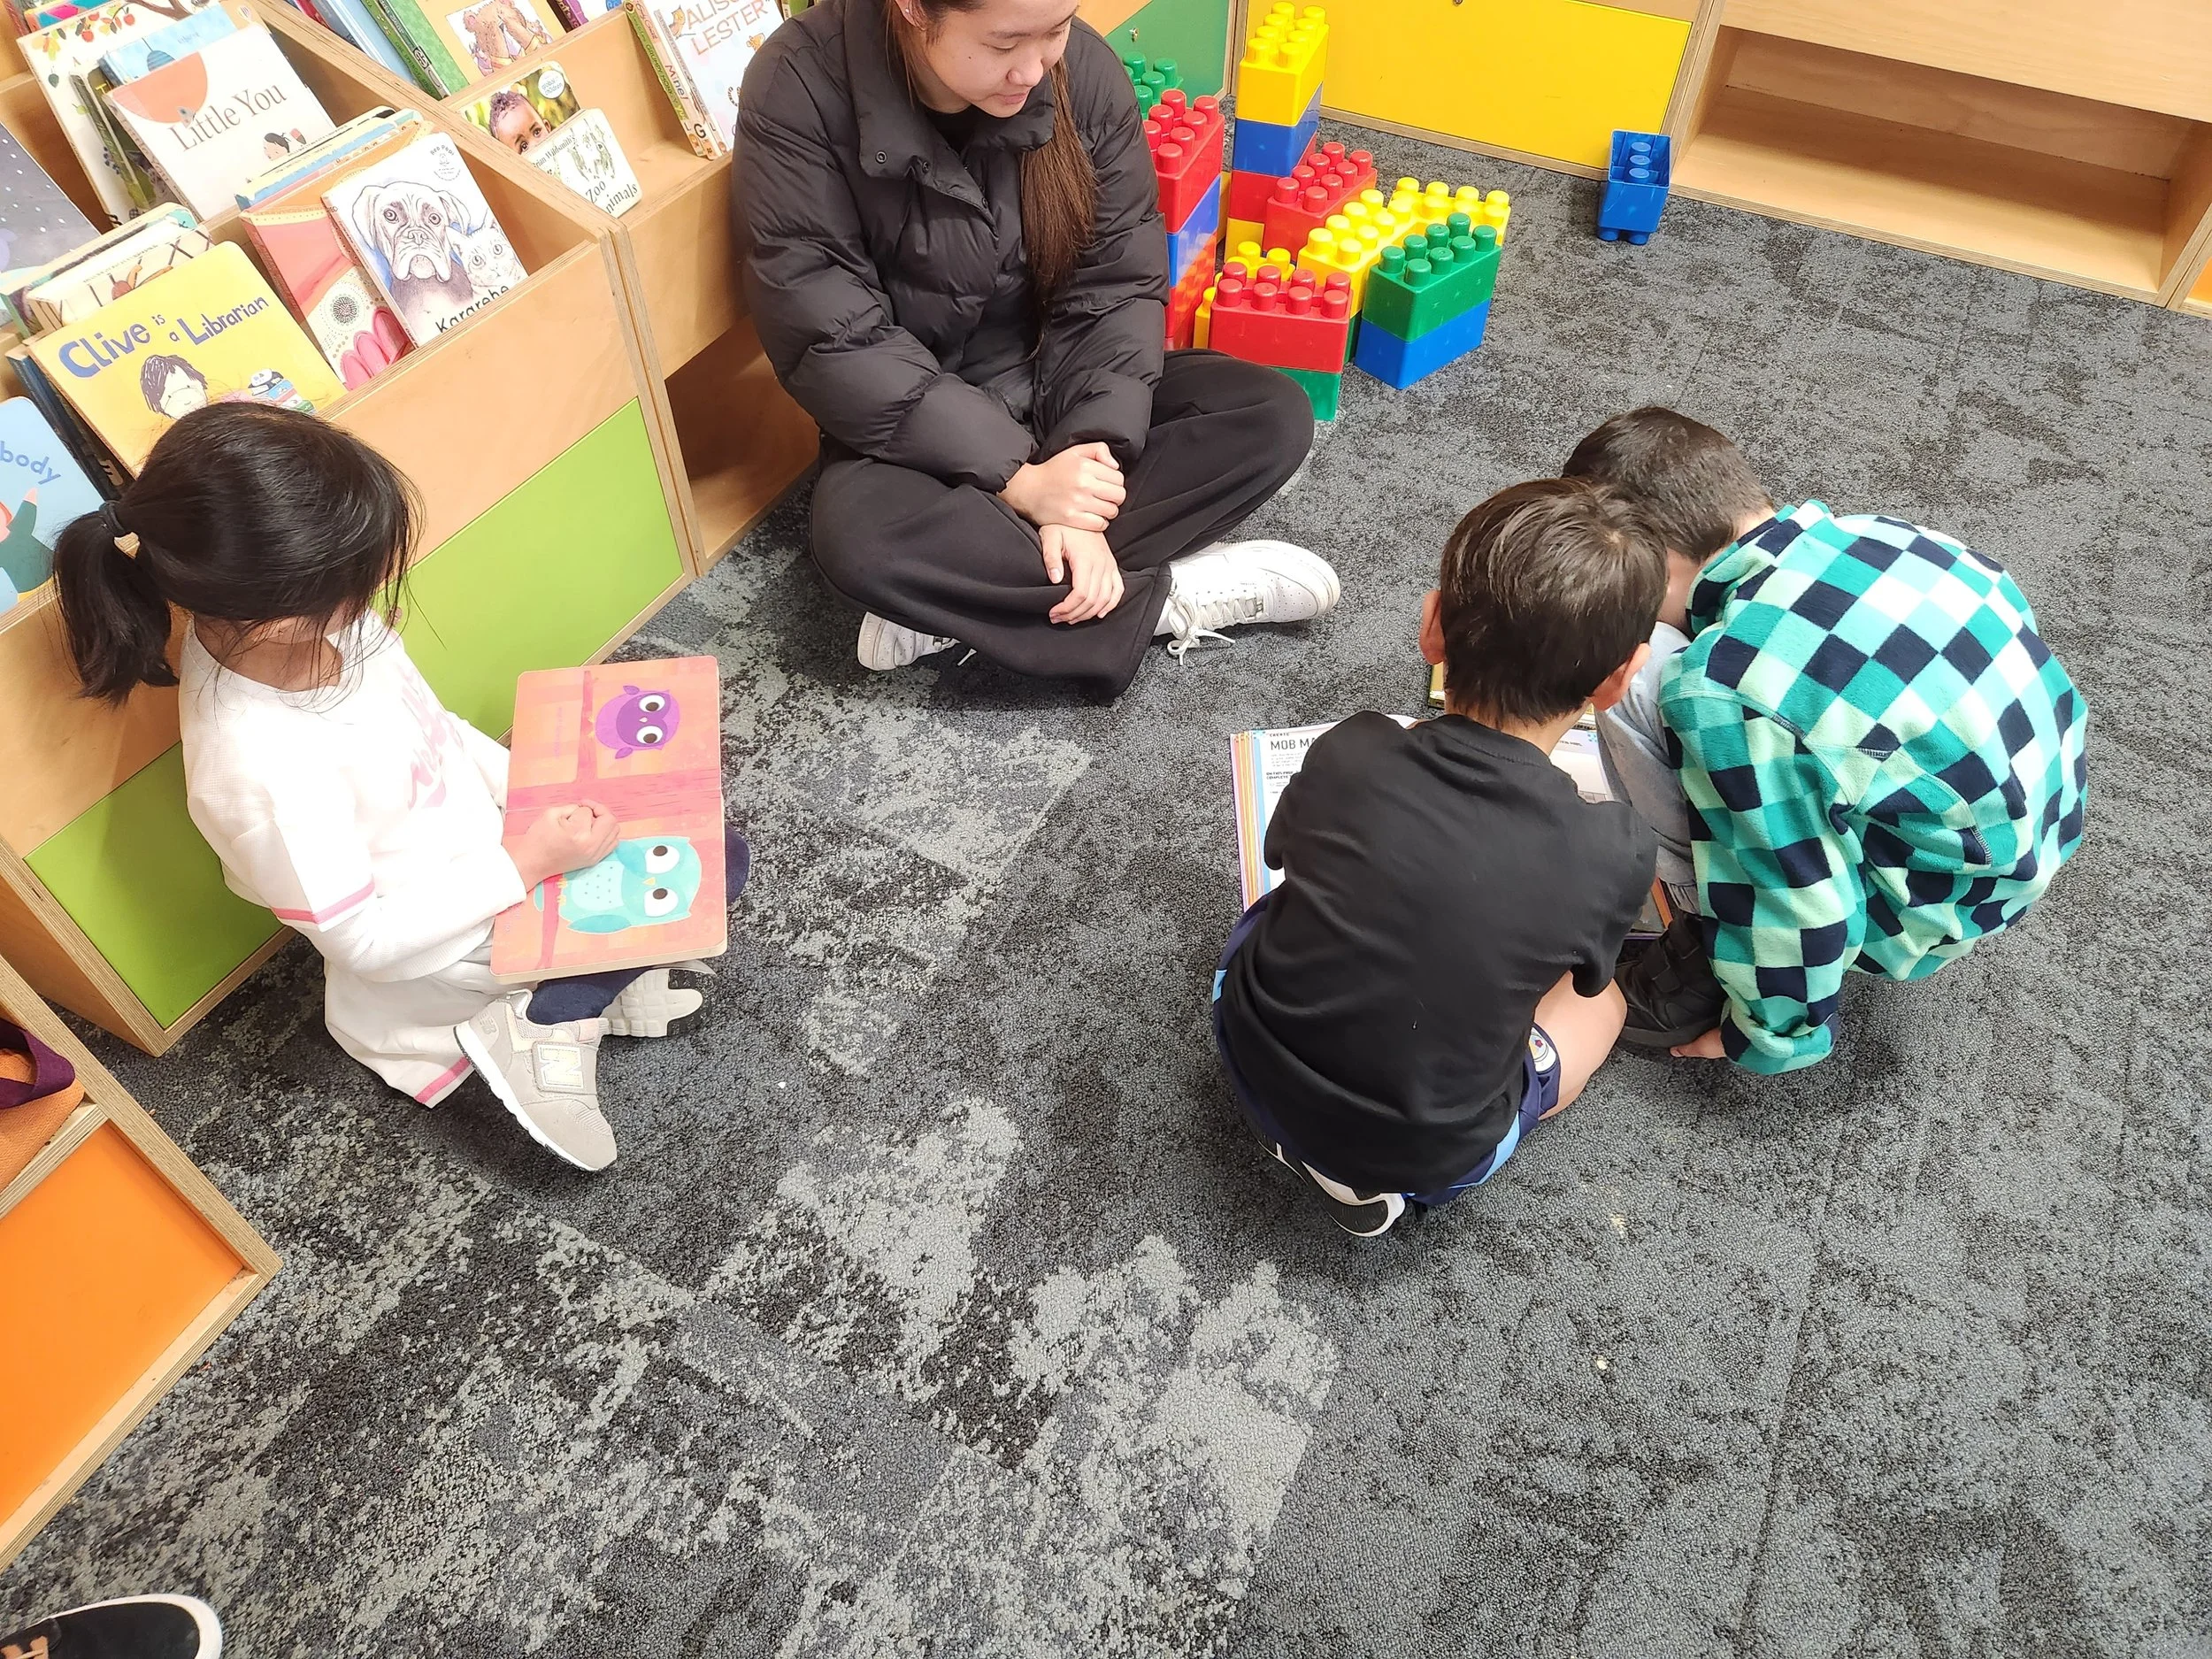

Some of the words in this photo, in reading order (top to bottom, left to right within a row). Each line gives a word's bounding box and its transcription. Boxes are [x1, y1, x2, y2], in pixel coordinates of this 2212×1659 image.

[687, 0, 740, 30] ALIS
[691, 0, 768, 55] LESTER
[664, 65, 688, 100] Mine!
[167, 105, 241, 151] Little
[231, 85, 288, 117] You
[585, 180, 606, 204] Zoo
[605, 183, 638, 214] nimals
[58, 324, 150, 378] Clive
[151, 314, 165, 326] is
[169, 332, 180, 342] a
[177, 296, 269, 345] Librarian
[1271, 740, 1295, 750] MOB
